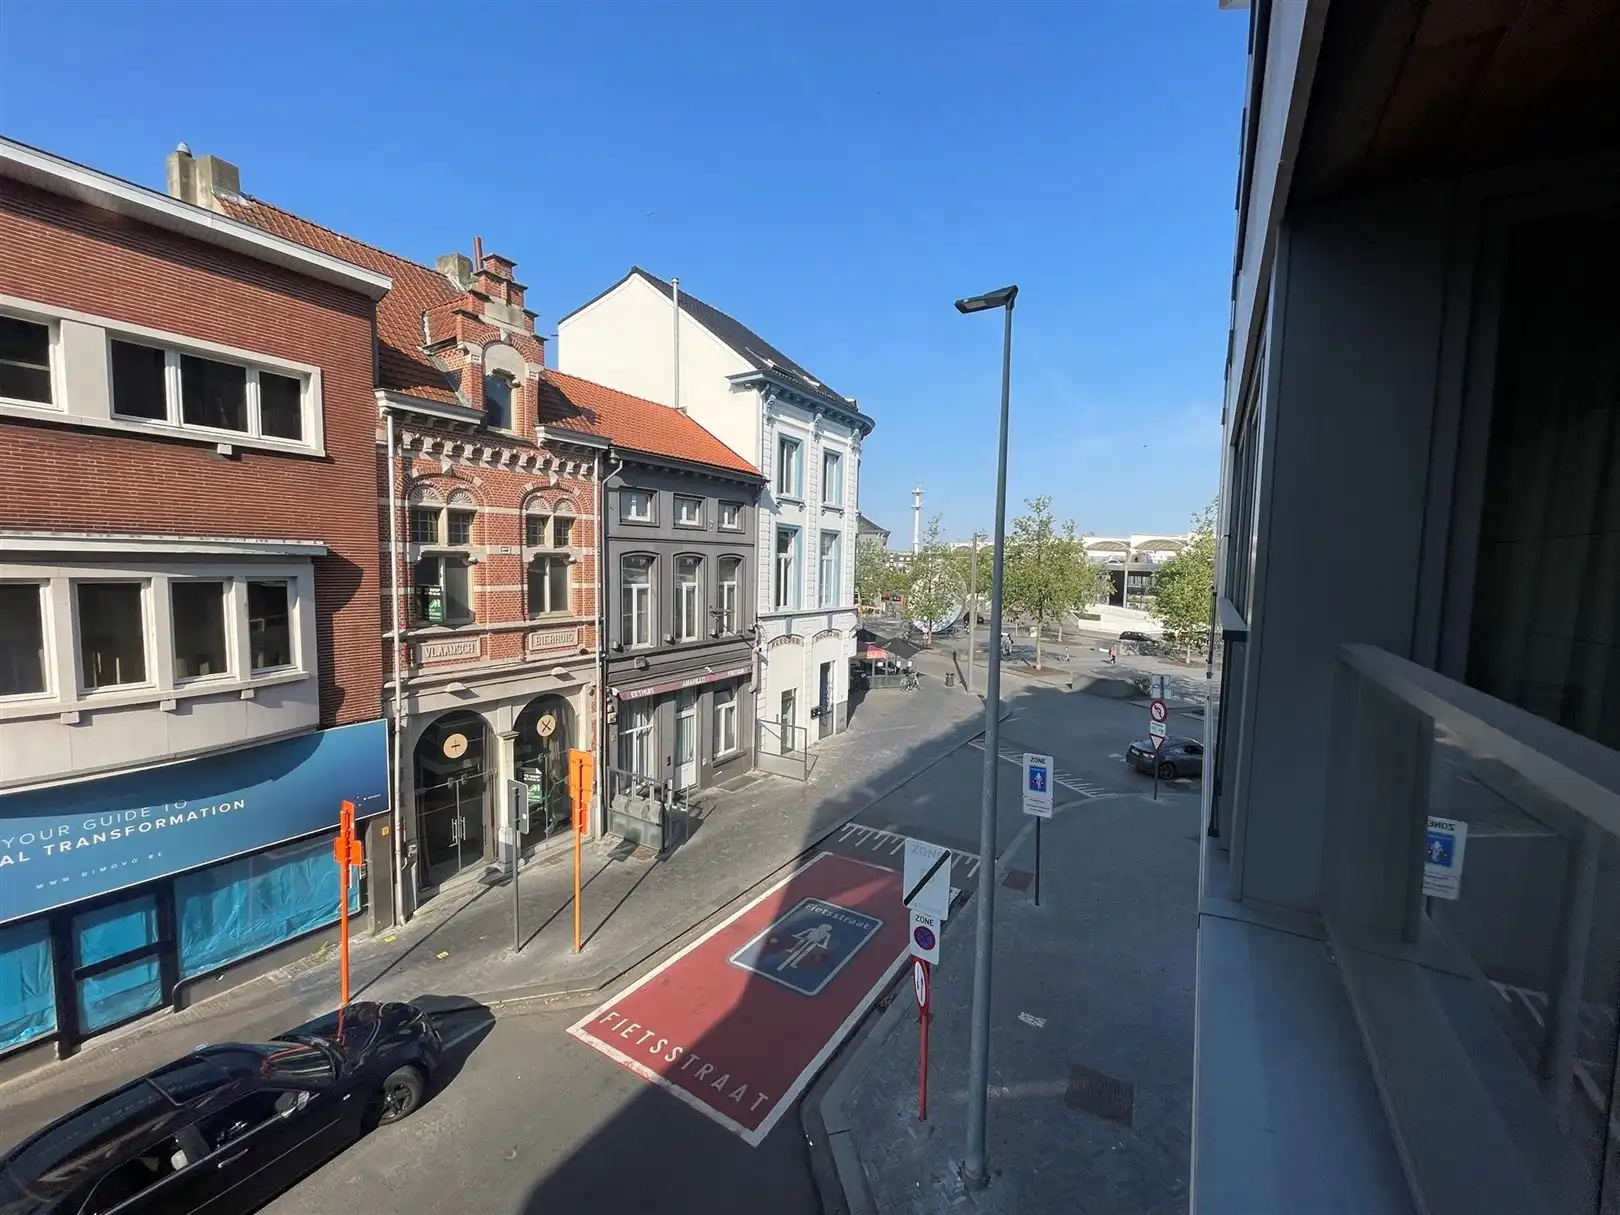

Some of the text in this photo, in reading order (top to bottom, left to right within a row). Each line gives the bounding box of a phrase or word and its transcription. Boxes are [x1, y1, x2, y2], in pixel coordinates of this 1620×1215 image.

[536, 632, 574, 647] BIERHUIS
[630, 687, 655, 698] EETHUIS
[1030, 756, 1046, 764] ZONE
[1, 799, 188, 849] YOUR GUIDE TO
[0, 799, 246, 868] AL TRANSFORMATION
[915, 914, 934, 927] ZONE
[599, 1011, 769, 1112] FIETSSTRAAT
